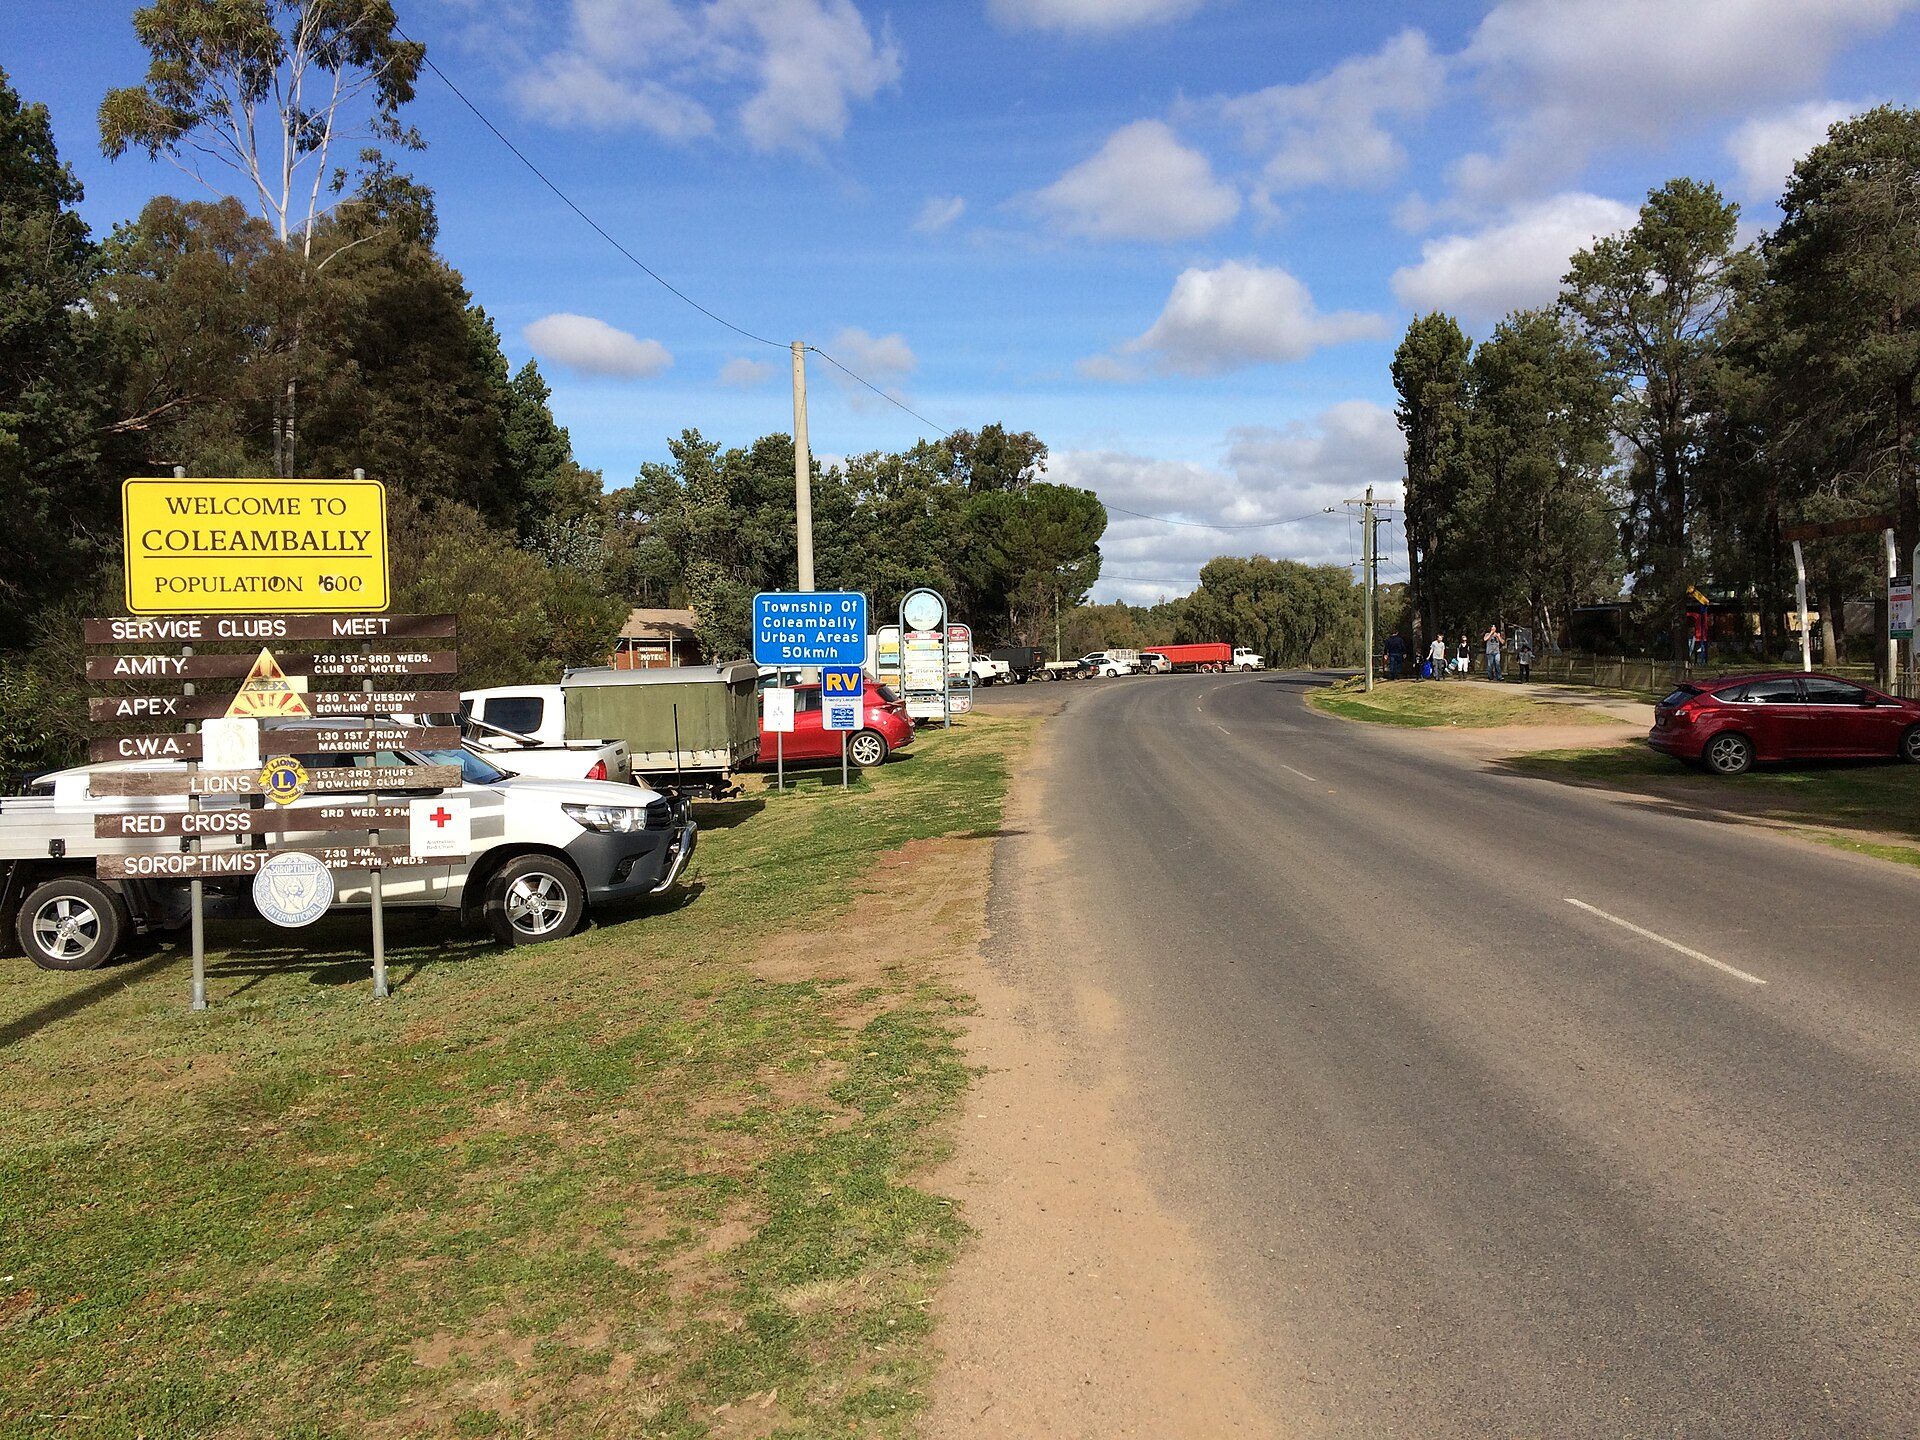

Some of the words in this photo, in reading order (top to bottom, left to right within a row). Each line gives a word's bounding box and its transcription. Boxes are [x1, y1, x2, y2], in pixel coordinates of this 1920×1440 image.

[165, 497, 301, 516] WELCOME
[311, 497, 347, 516] TO
[142, 529, 372, 551] COLEAMBALLY
[155, 575, 303, 593] POPULATION
[761, 601, 832, 614] Township
[841, 600, 858, 612] Of
[111, 620, 202, 640] SERVICE
[218, 619, 287, 637] CLUBS
[332, 618, 391, 636] MEET
[762, 616, 857, 630] Coleambally
[761, 631, 805, 643] Urban
[815, 631, 859, 643] Areas
[313, 654, 336, 663] 7.30
[397, 653, 432, 663] WEDS.
[782, 646, 838, 658] 50km/h
[113, 657, 187, 675] AMITY
[314, 664, 344, 674] CLUB
[350, 664, 366, 673] OR
[371, 664, 409, 673] MOTEL
[826, 672, 860, 691] RV
[315, 693, 340, 703] 7.30
[366, 692, 416, 702] TUESDAY
[116, 698, 177, 716] APEX
[316, 704, 368, 713] BOWLING
[374, 703, 403, 712] CLUB
[316, 731, 339, 740] 1.30
[343, 731, 363, 740] 1ST
[368, 730, 409, 739] FRIDAY
[118, 738, 184, 756] C.W.A.
[318, 741, 370, 751] MASONIC
[376, 740, 406, 750] HALL
[272, 759, 297, 769] LIONS
[276, 771, 292, 789] L
[316, 770, 336, 779] 1ST
[377, 768, 414, 777] THURS
[189, 775, 251, 793] LIONS
[317, 779, 369, 789] BOWLING
[376, 778, 406, 787] CLUB
[320, 809, 344, 818] 3RD
[350, 808, 379, 817] WED.
[122, 815, 165, 833] RED
[181, 813, 251, 832] CROSS
[324, 849, 347, 858] 7.30
[124, 852, 269, 875] SOROPTIMIST
[391, 856, 428, 865] WEDS.
[270, 864, 317, 874] SOROPTIMIST
[266, 903, 321, 923] INTERNATIONAL
